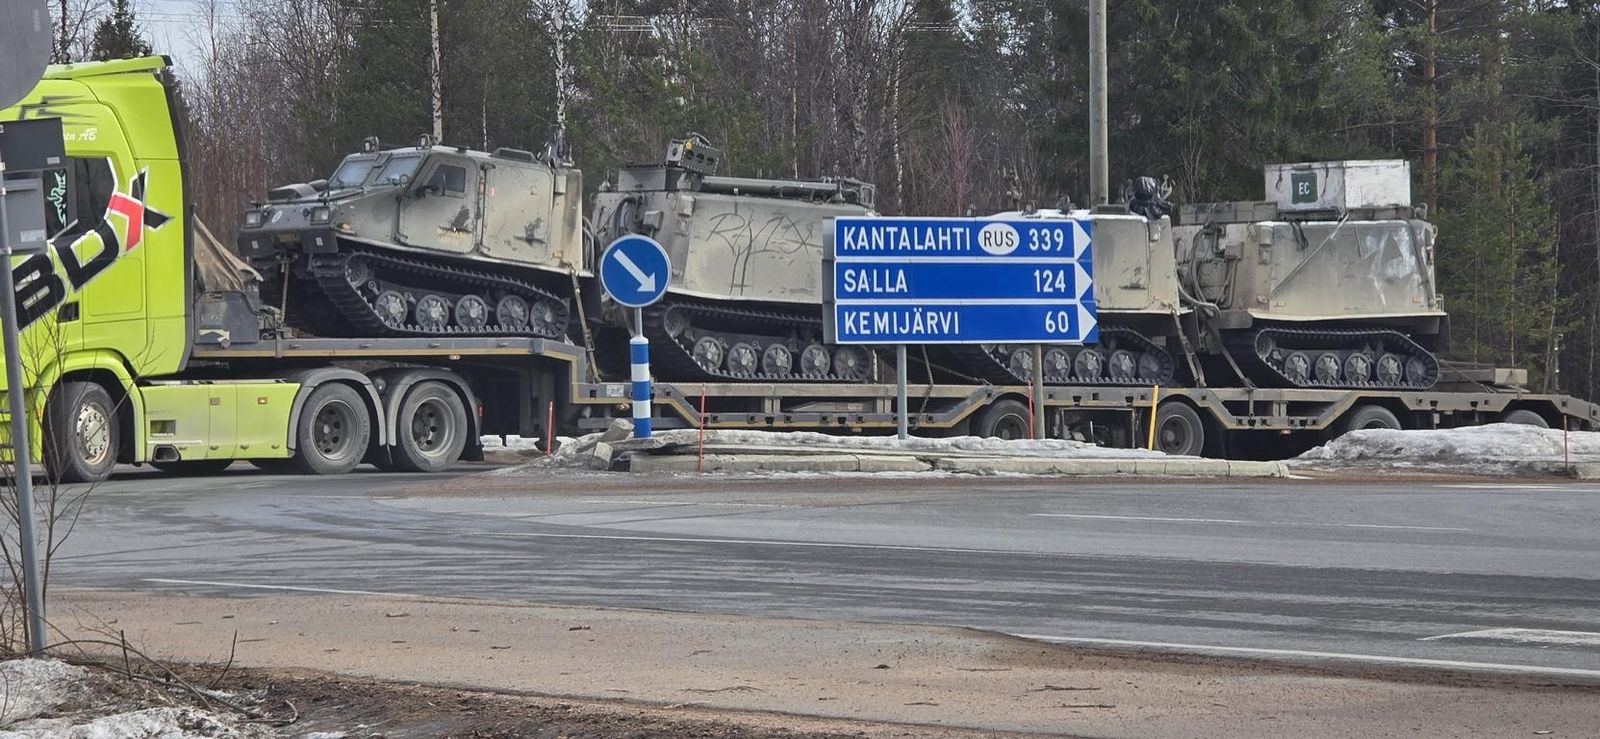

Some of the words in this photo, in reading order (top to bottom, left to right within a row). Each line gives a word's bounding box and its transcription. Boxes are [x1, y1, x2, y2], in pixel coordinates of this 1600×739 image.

[78, 127, 98, 141] AB
[1298, 182, 1310, 195] EC
[11, 165, 175, 331] BDX
[843, 226, 971, 252] KANTALAHTI
[983, 230, 1015, 248] RUS
[1028, 228, 1065, 252] 339
[843, 269, 908, 293] SALLA
[1033, 269, 1066, 293] 124
[844, 308, 960, 335] KEMIJÄRVI
[1045, 311, 1069, 334] 60
